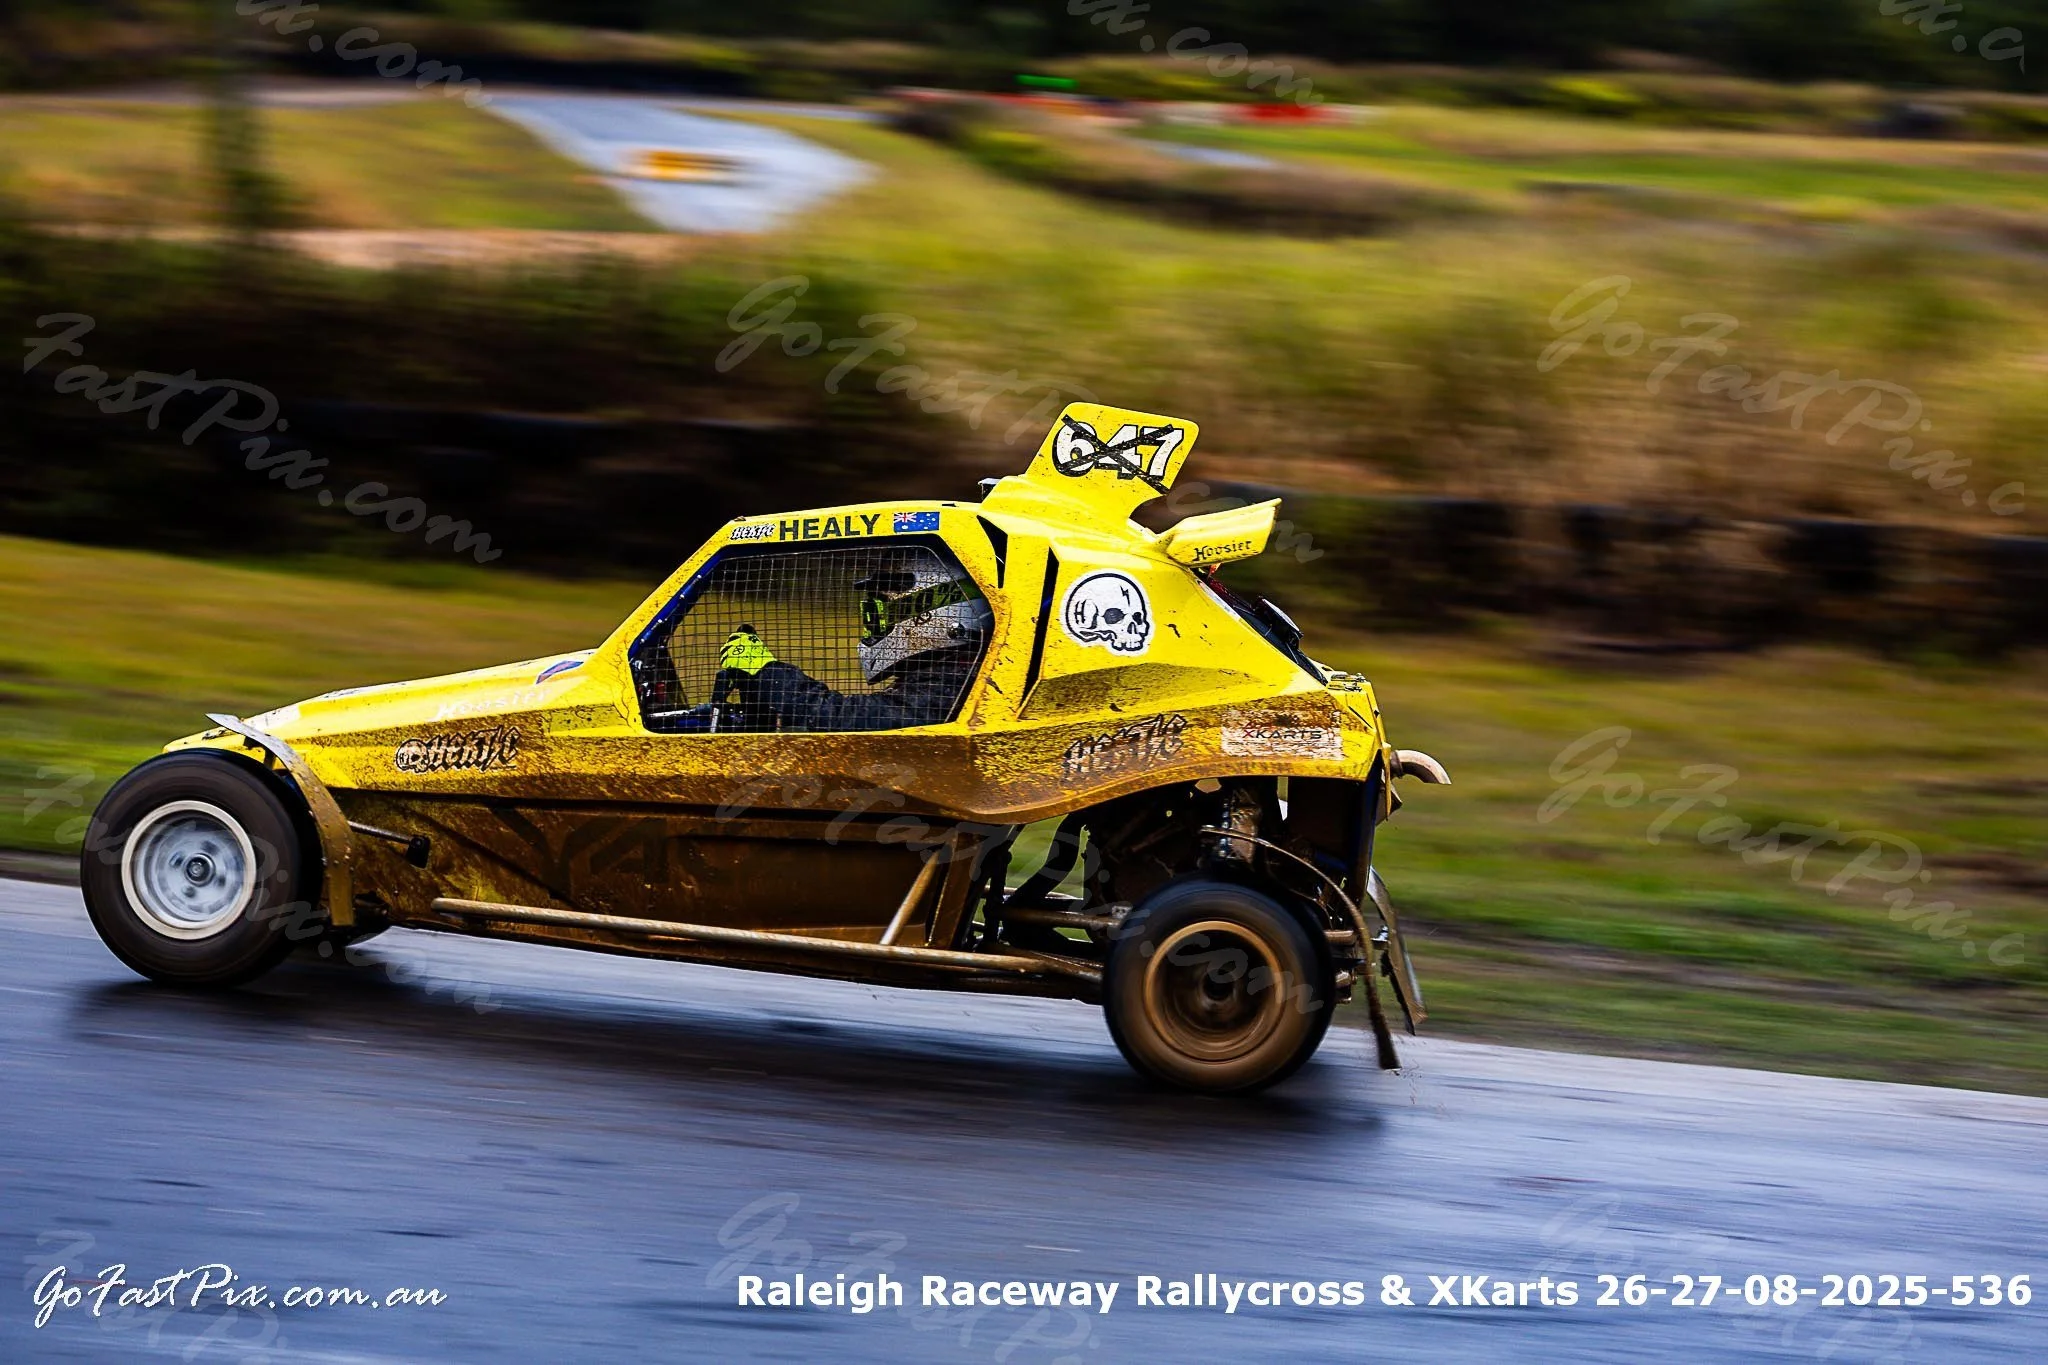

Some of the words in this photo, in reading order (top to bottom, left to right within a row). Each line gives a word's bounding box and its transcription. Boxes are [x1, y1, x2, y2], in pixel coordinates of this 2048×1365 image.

[779, 514, 881, 540] HEALY
[1192, 540, 1252, 561] Hoosier
[1243, 729, 1322, 739] XKARTS
